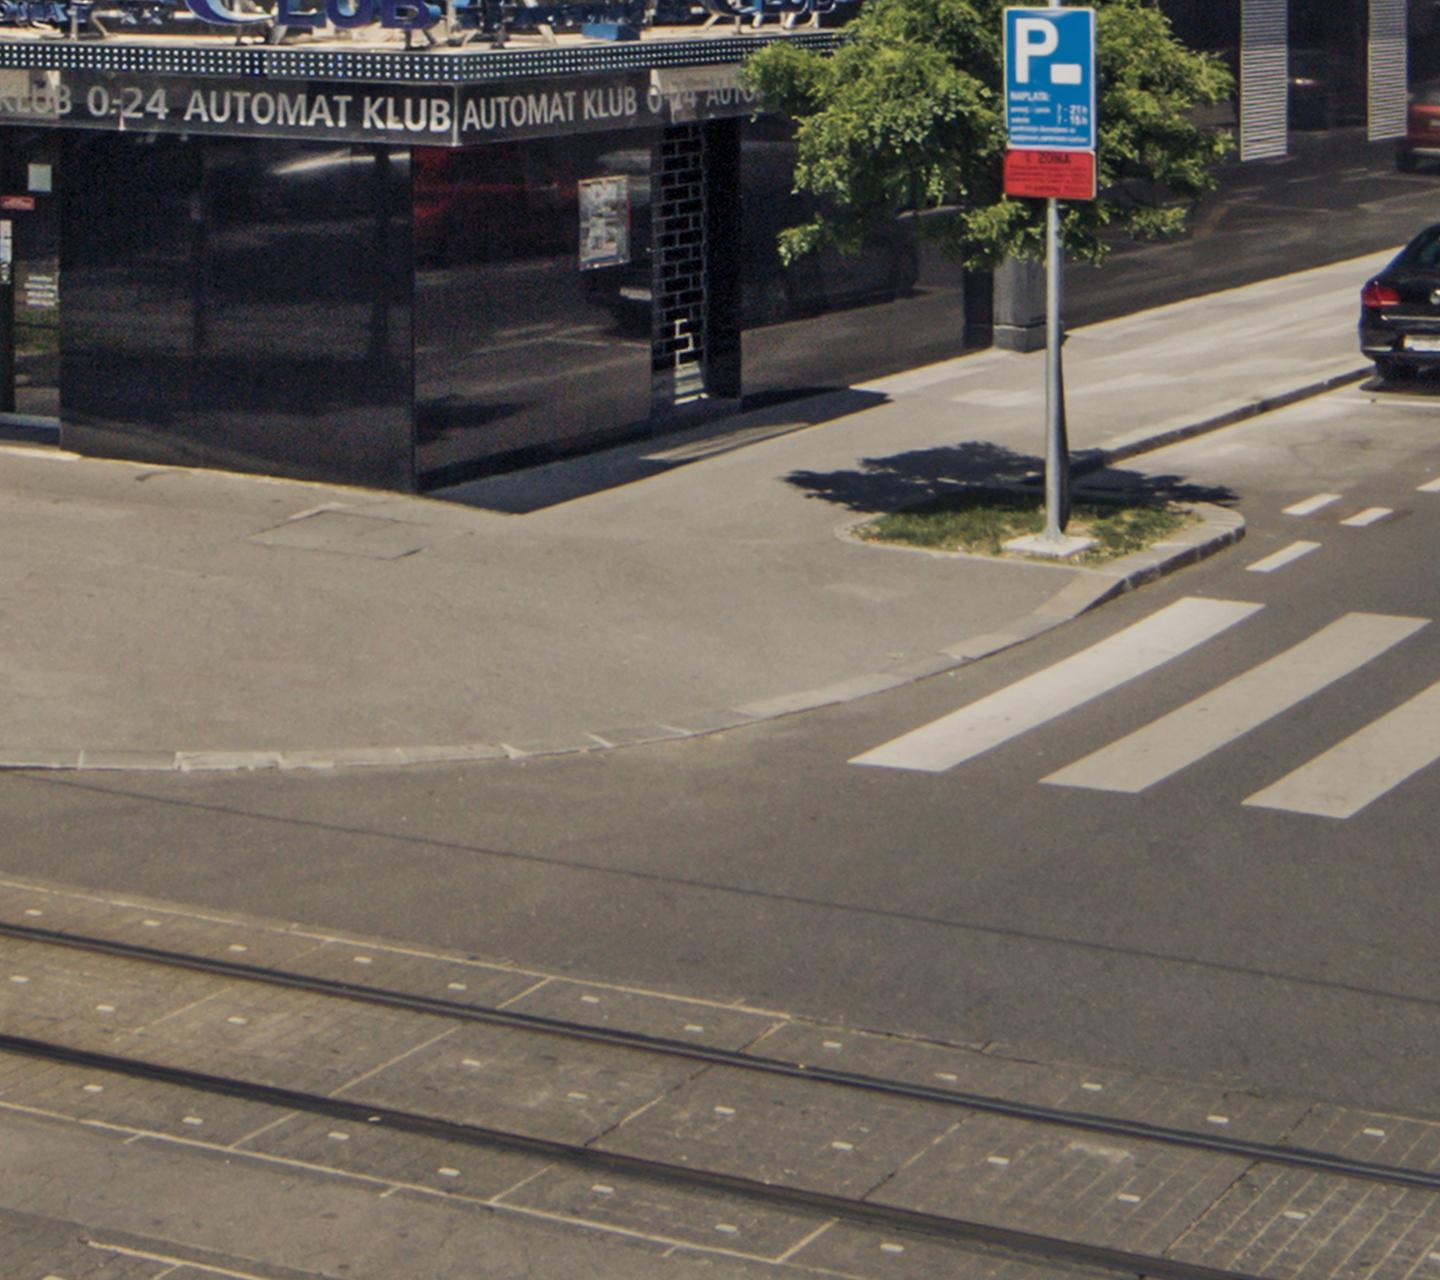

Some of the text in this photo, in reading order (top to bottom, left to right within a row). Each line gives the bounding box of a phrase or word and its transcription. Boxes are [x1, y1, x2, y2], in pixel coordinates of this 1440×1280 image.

[1014, 18, 1059, 84] P
[183, 88, 352, 128] AUTOMAT
[362, 96, 452, 132] KLUB
[462, 91, 577, 131] AUTOMAT
[583, 85, 637, 119] KLUB
